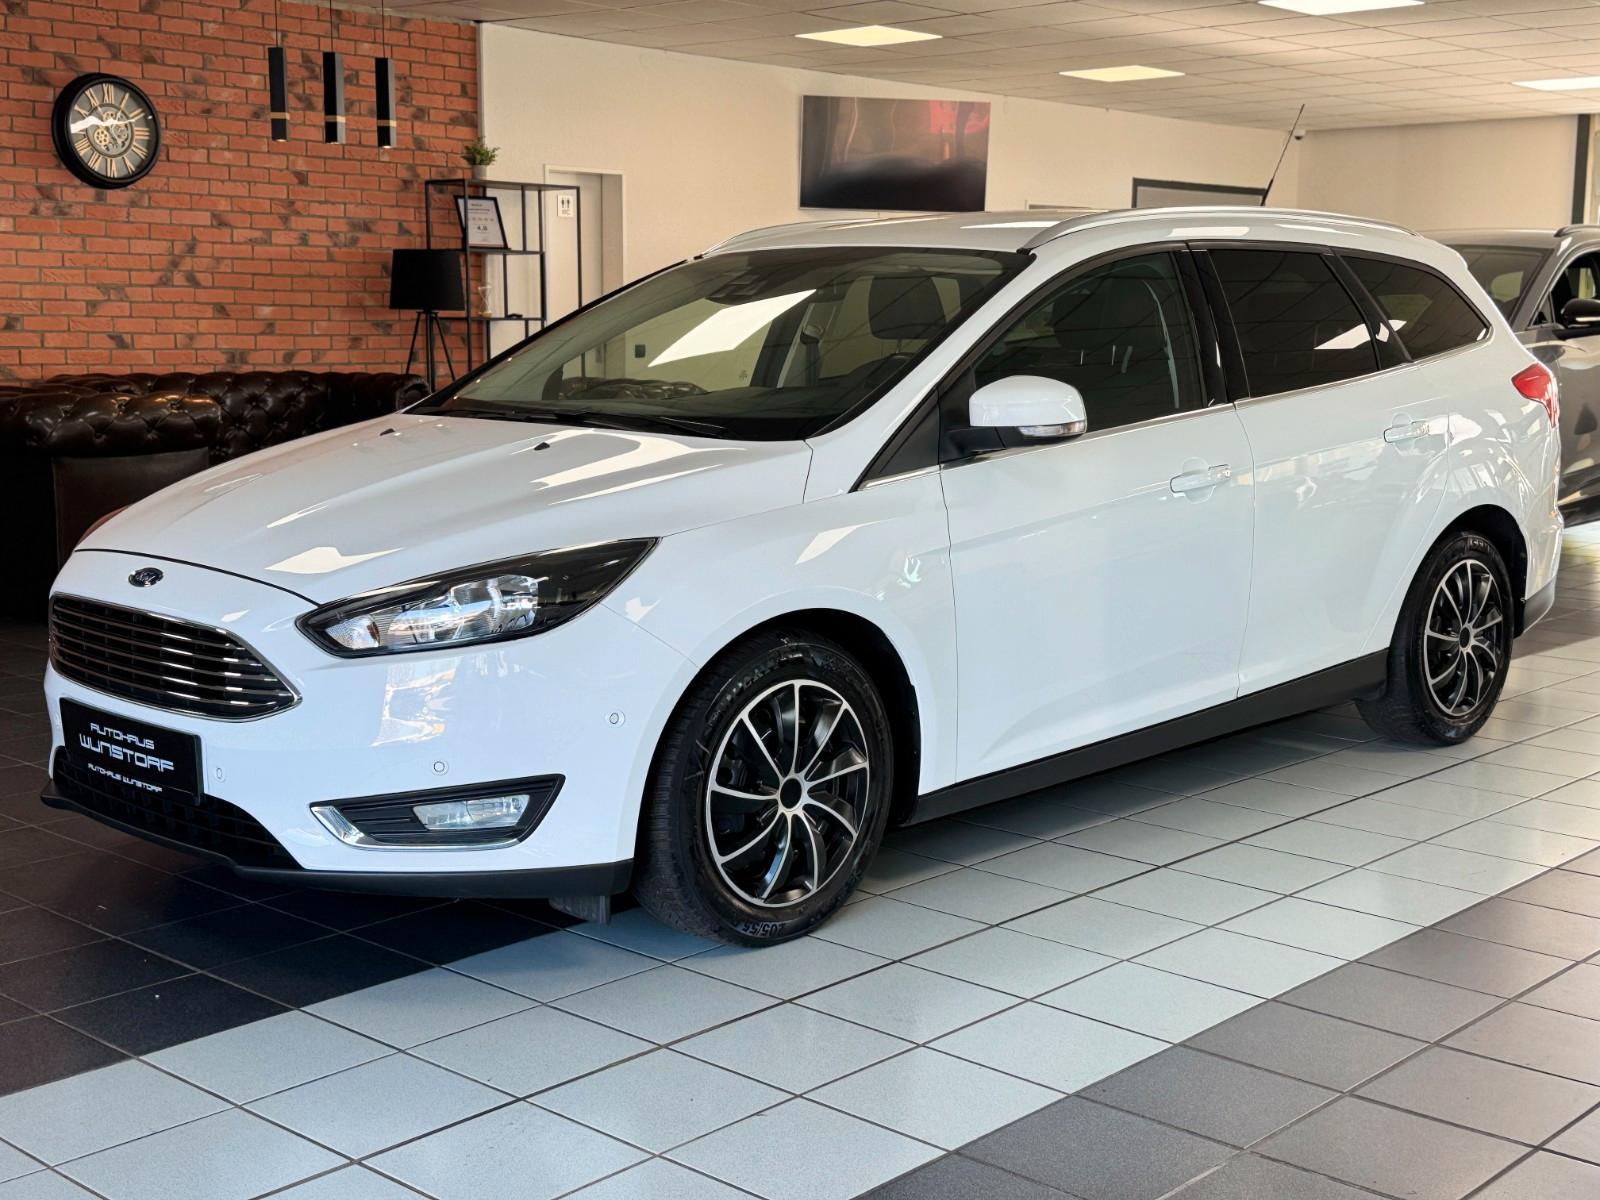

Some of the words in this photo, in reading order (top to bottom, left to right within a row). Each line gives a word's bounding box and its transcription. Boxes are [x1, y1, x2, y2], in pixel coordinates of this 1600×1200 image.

[90, 722, 155, 750] AUTOHAUS
[79, 733, 175, 773] WUNSTORF
[87, 763, 122, 781] AUTOHAUS
[122, 776, 163, 793] WUNSTORF
